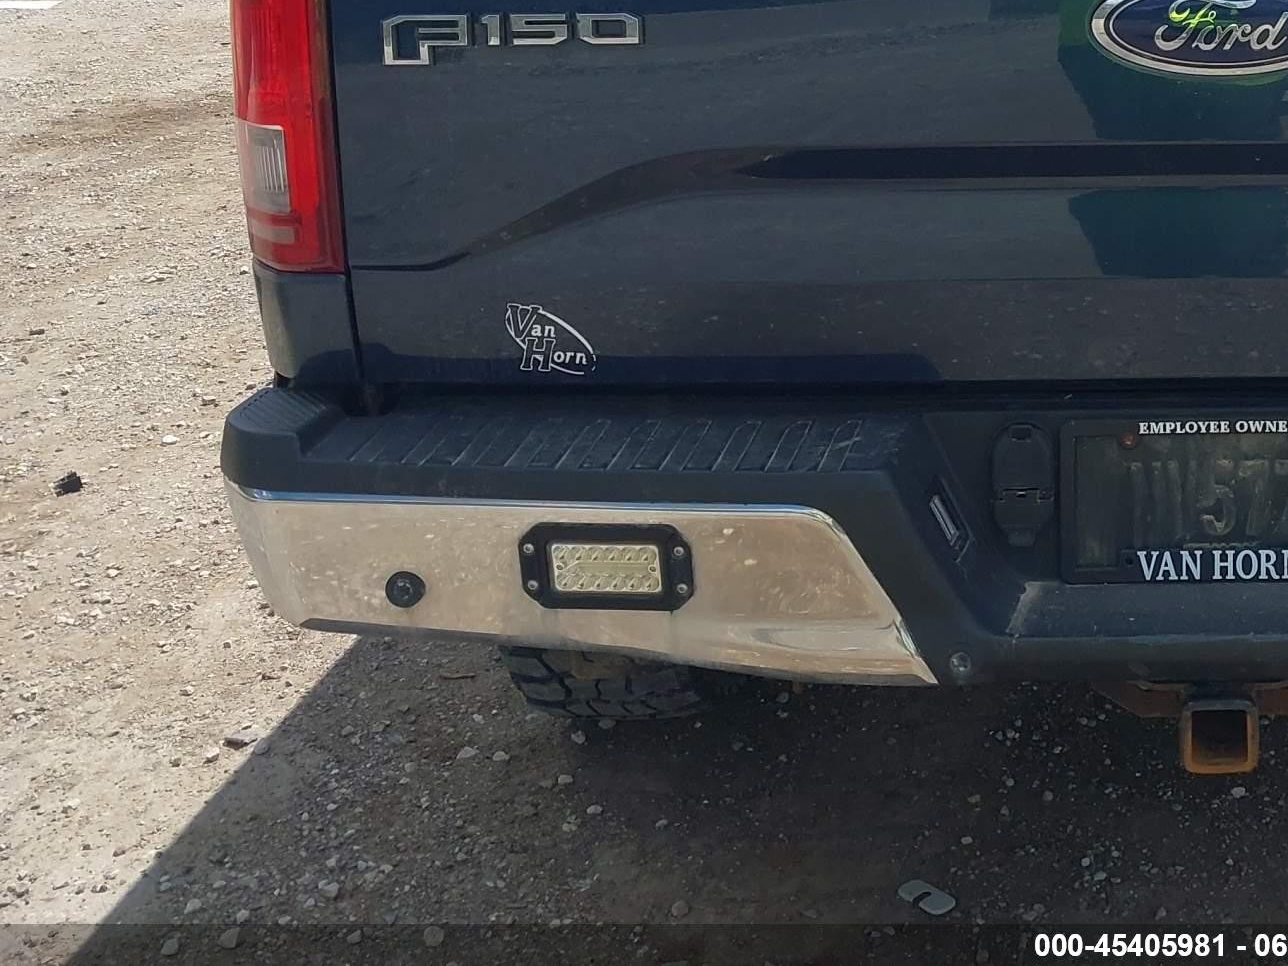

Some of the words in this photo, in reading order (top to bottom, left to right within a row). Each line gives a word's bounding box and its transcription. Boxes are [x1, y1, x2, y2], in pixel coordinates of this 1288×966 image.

[506, 303, 556, 340] Van
[520, 337, 588, 372] Horn
[1138, 421, 1230, 435] EMPLOYEE
[1137, 550, 1203, 581] VAN
